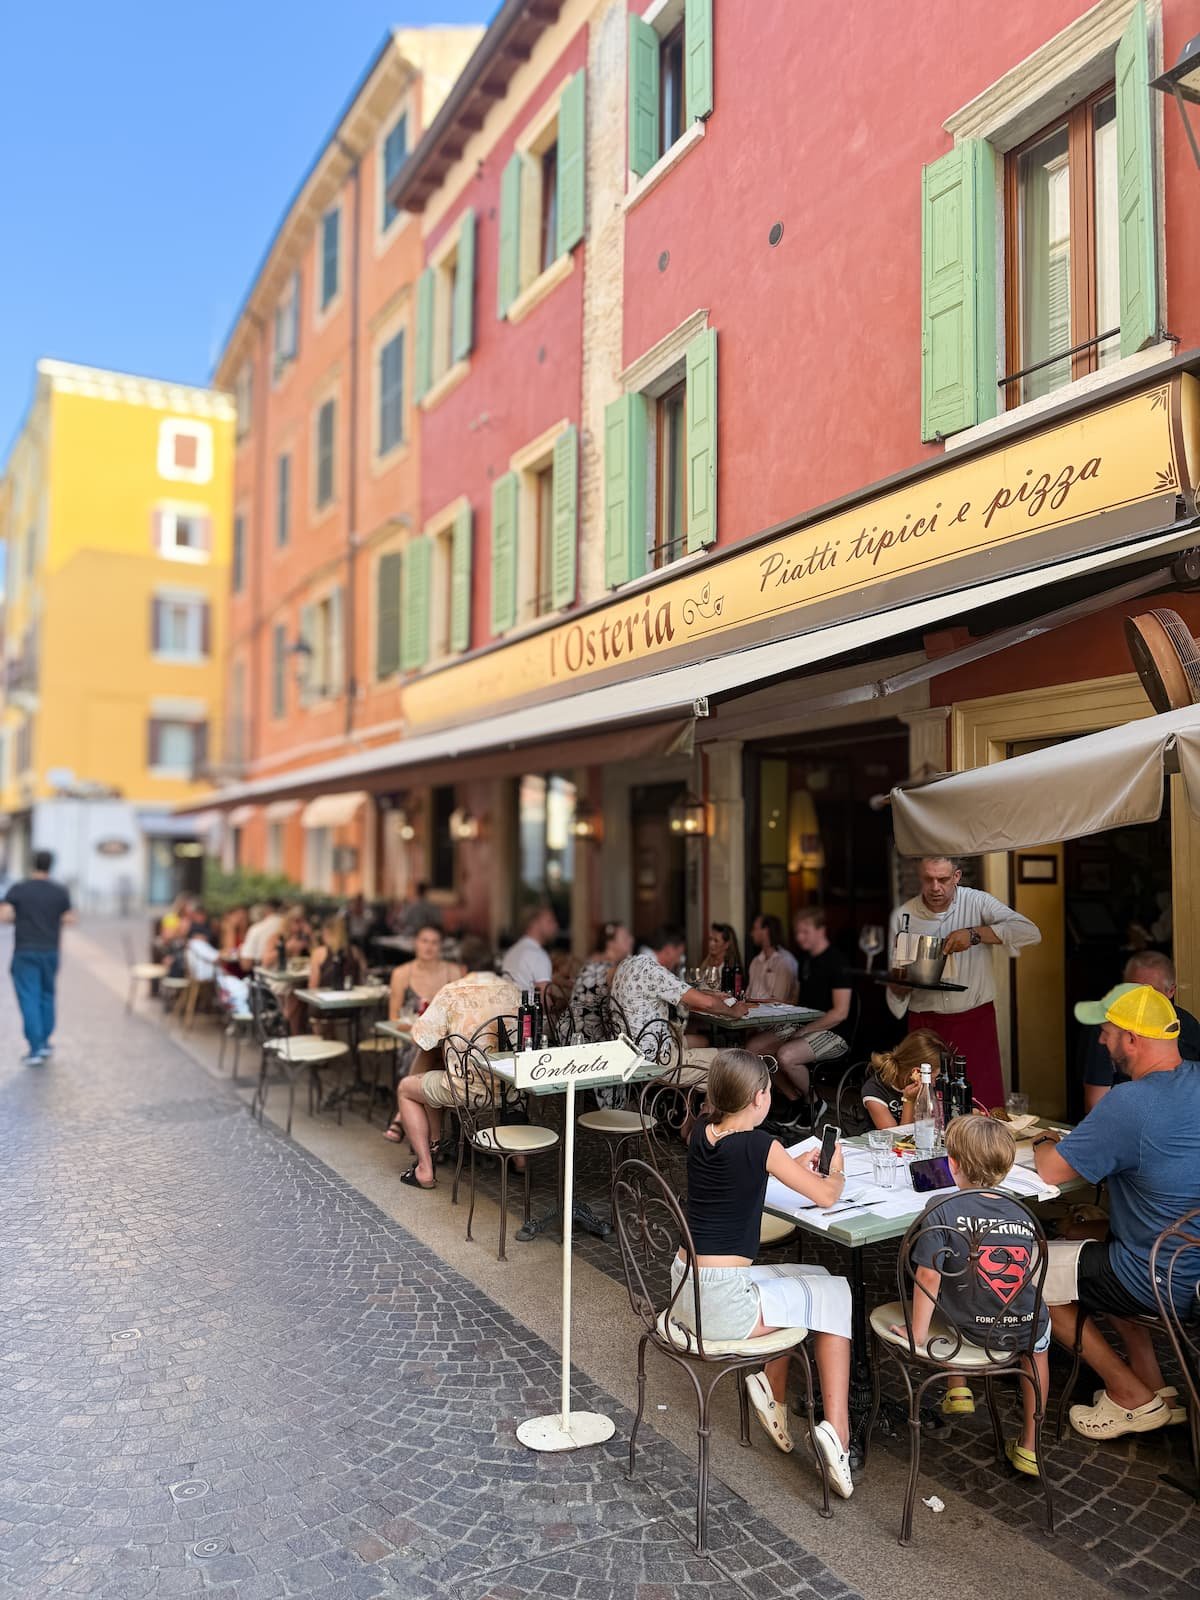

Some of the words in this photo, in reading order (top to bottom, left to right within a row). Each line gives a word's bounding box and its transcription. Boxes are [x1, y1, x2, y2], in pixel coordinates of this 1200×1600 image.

[759, 540, 841, 592] Piatti
[846, 502, 943, 566] tipici
[947, 500, 970, 527] e
[981, 456, 1103, 529] pizza
[550, 594, 675, 677] l'Osteria
[530, 1053, 609, 1081] Entrata
[975, 1315, 1001, 1324] FORC
[1003, 1315, 1018, 1324] FOR
